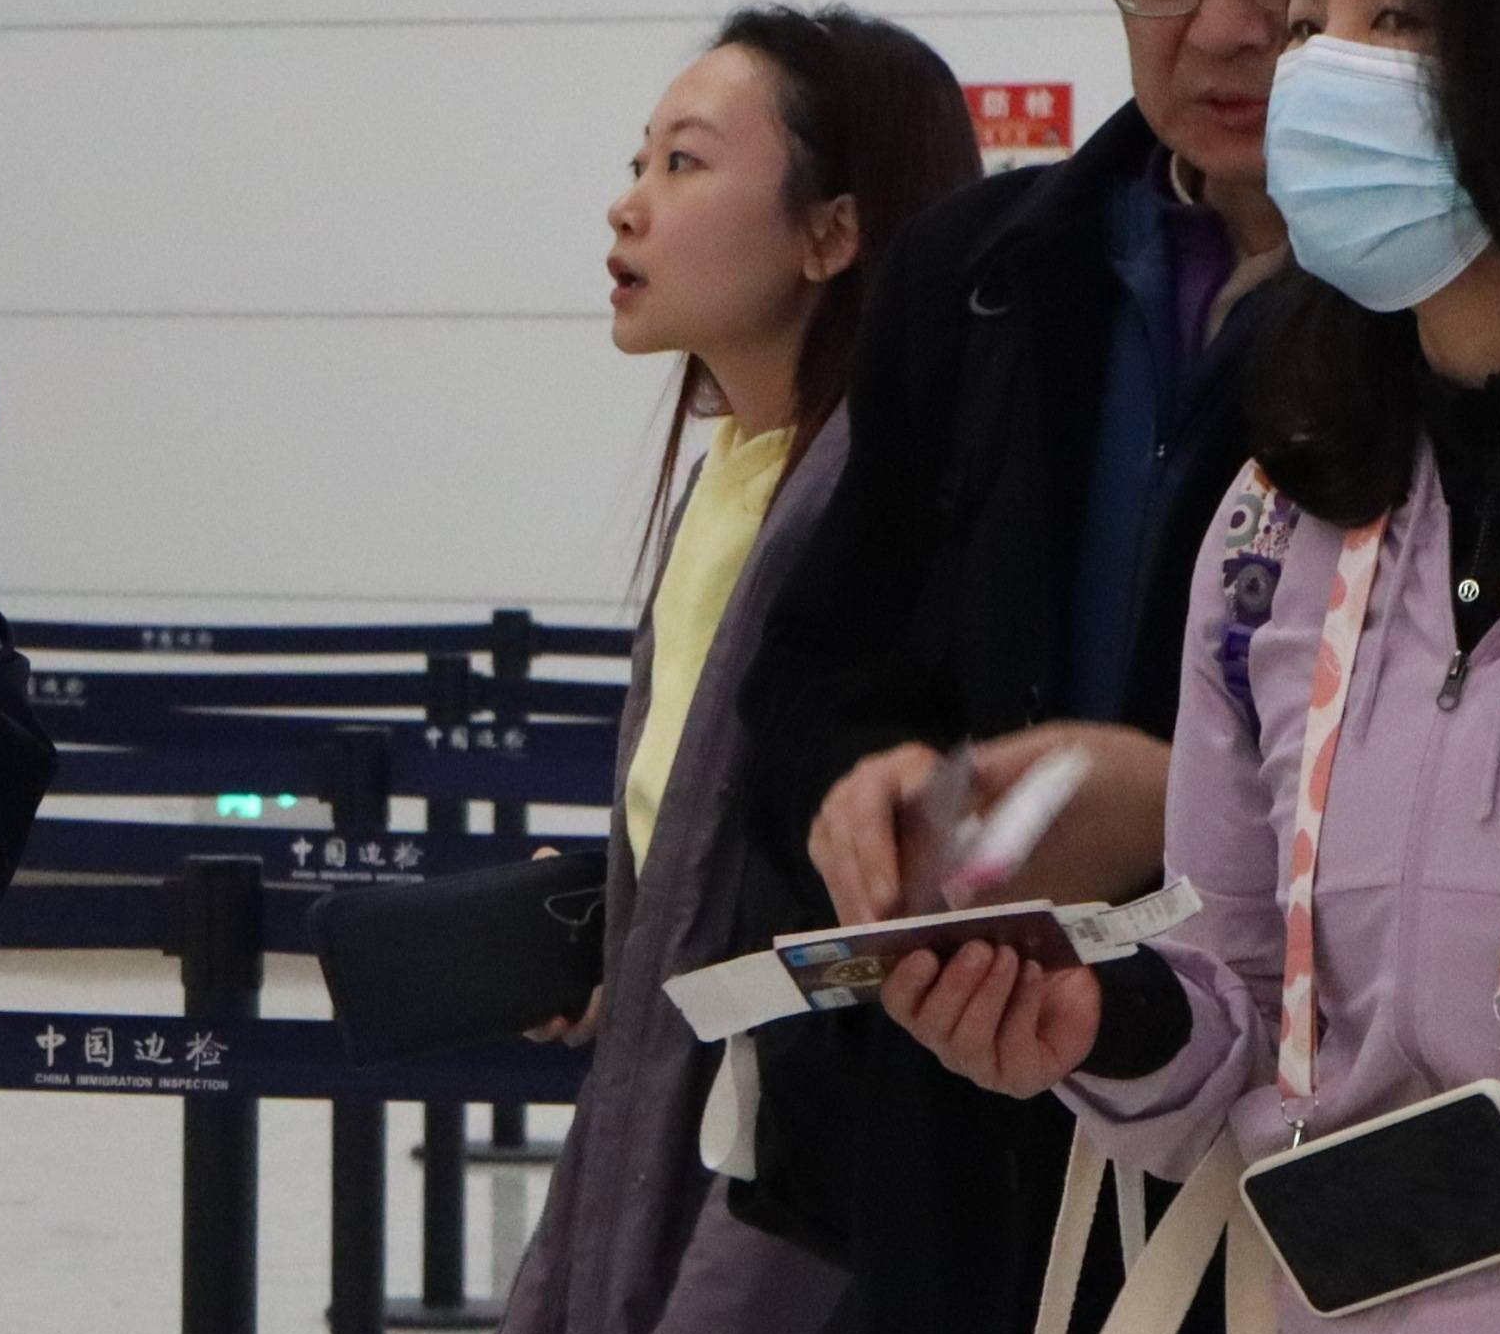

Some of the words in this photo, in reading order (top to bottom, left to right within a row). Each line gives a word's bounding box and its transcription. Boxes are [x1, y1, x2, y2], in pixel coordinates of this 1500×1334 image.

[291, 835, 424, 871] 中国边检
[35, 1024, 229, 1072] 中国边检
[34, 1072, 71, 1086] CHINA
[76, 1073, 153, 1089] IMMIGRATION
[158, 1076, 229, 1092] INSPECTION
